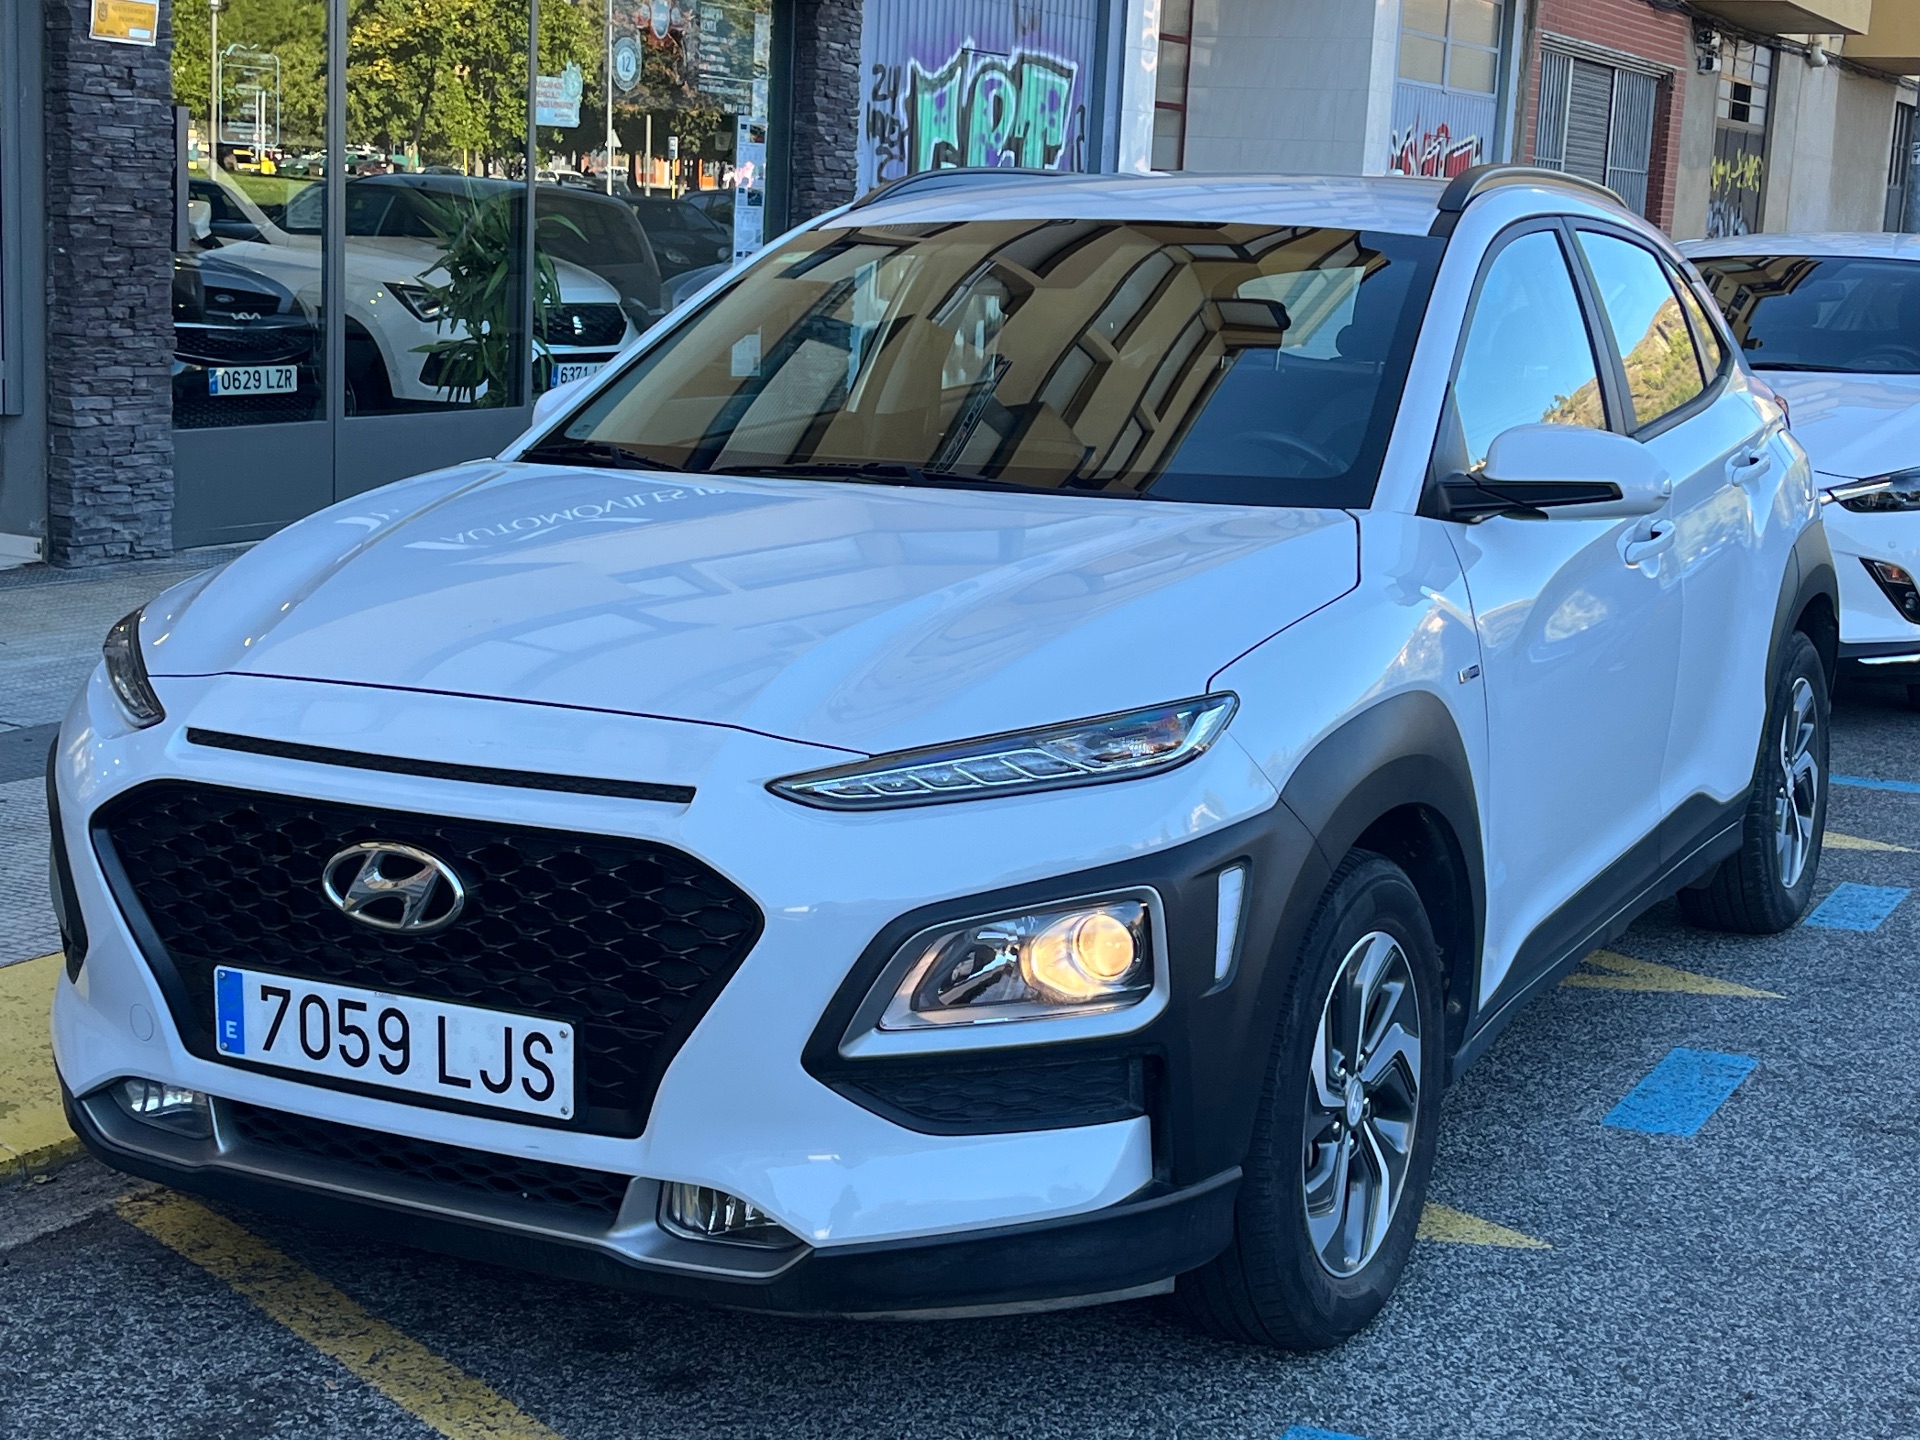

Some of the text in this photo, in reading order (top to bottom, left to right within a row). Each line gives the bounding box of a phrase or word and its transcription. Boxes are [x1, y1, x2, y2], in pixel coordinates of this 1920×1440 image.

[221, 368, 292, 390] 0629 LZR
[560, 366, 588, 384] 6371
[225, 1020, 238, 1040] E
[260, 984, 555, 1102] 7059 LJS
